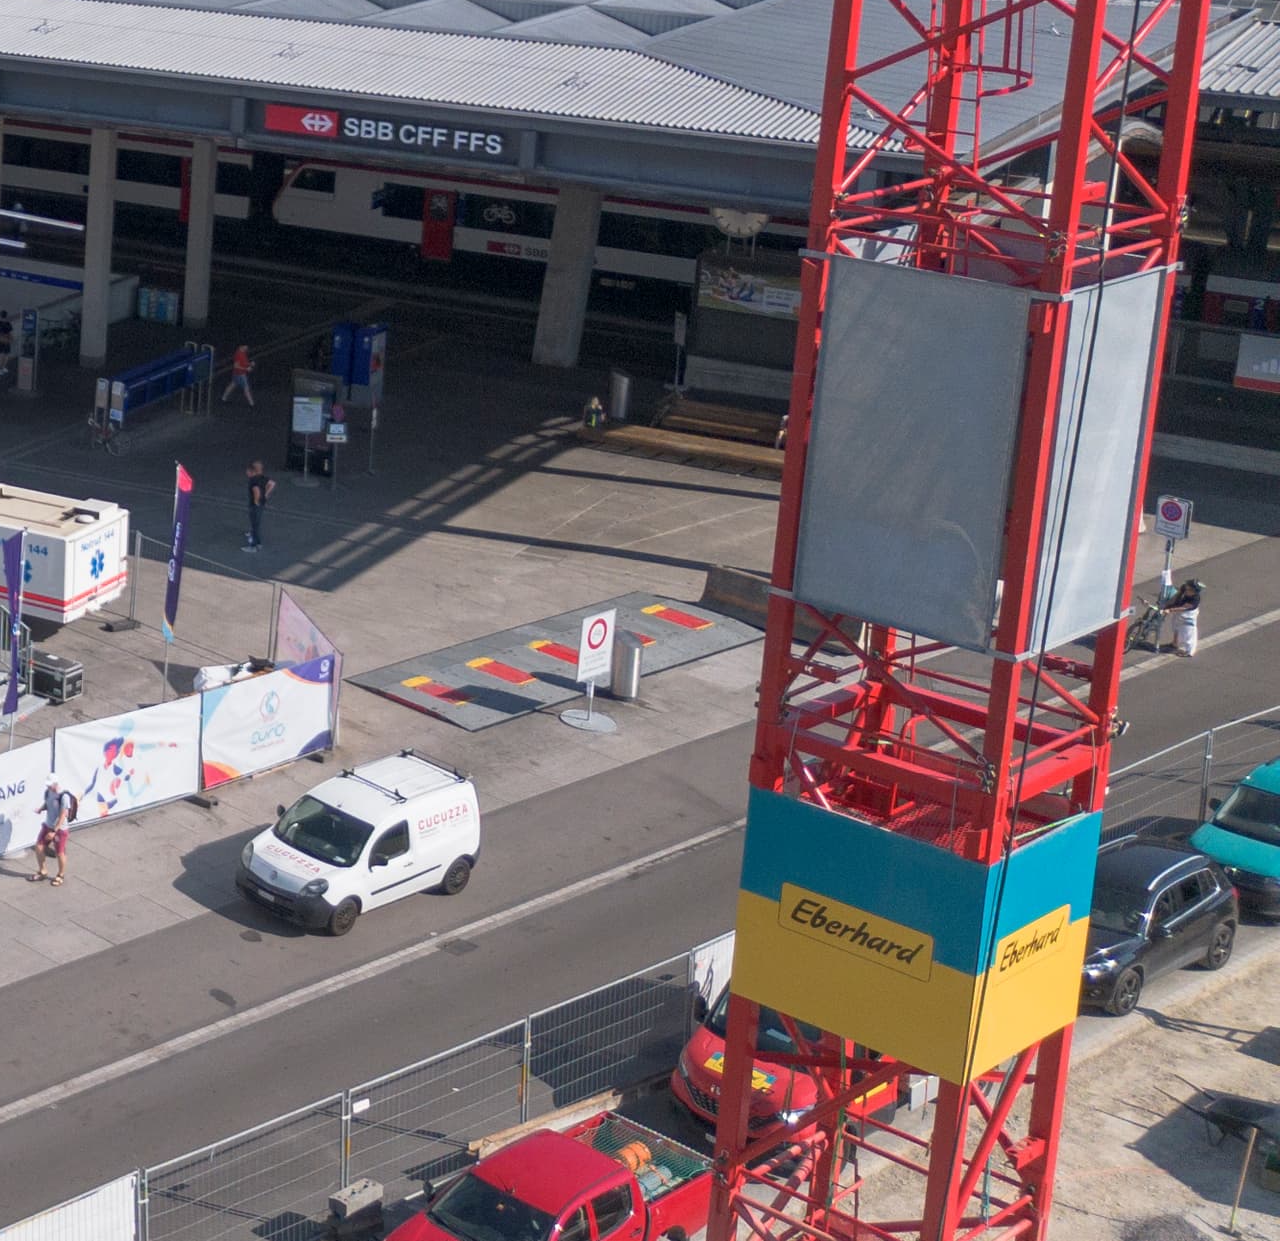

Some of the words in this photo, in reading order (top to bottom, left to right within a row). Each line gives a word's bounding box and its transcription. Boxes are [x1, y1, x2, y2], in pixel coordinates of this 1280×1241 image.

[343, 117, 394, 141] SBB
[398, 124, 448, 148] CFF
[453, 130, 503, 155] FFS
[28, 544, 49, 556] 144
[418, 803, 469, 831] CUCUZZA
[265, 844, 321, 874] CUCUZZA
[790, 898, 924, 964] Eberhard
[999, 916, 1065, 973] Eberhard
